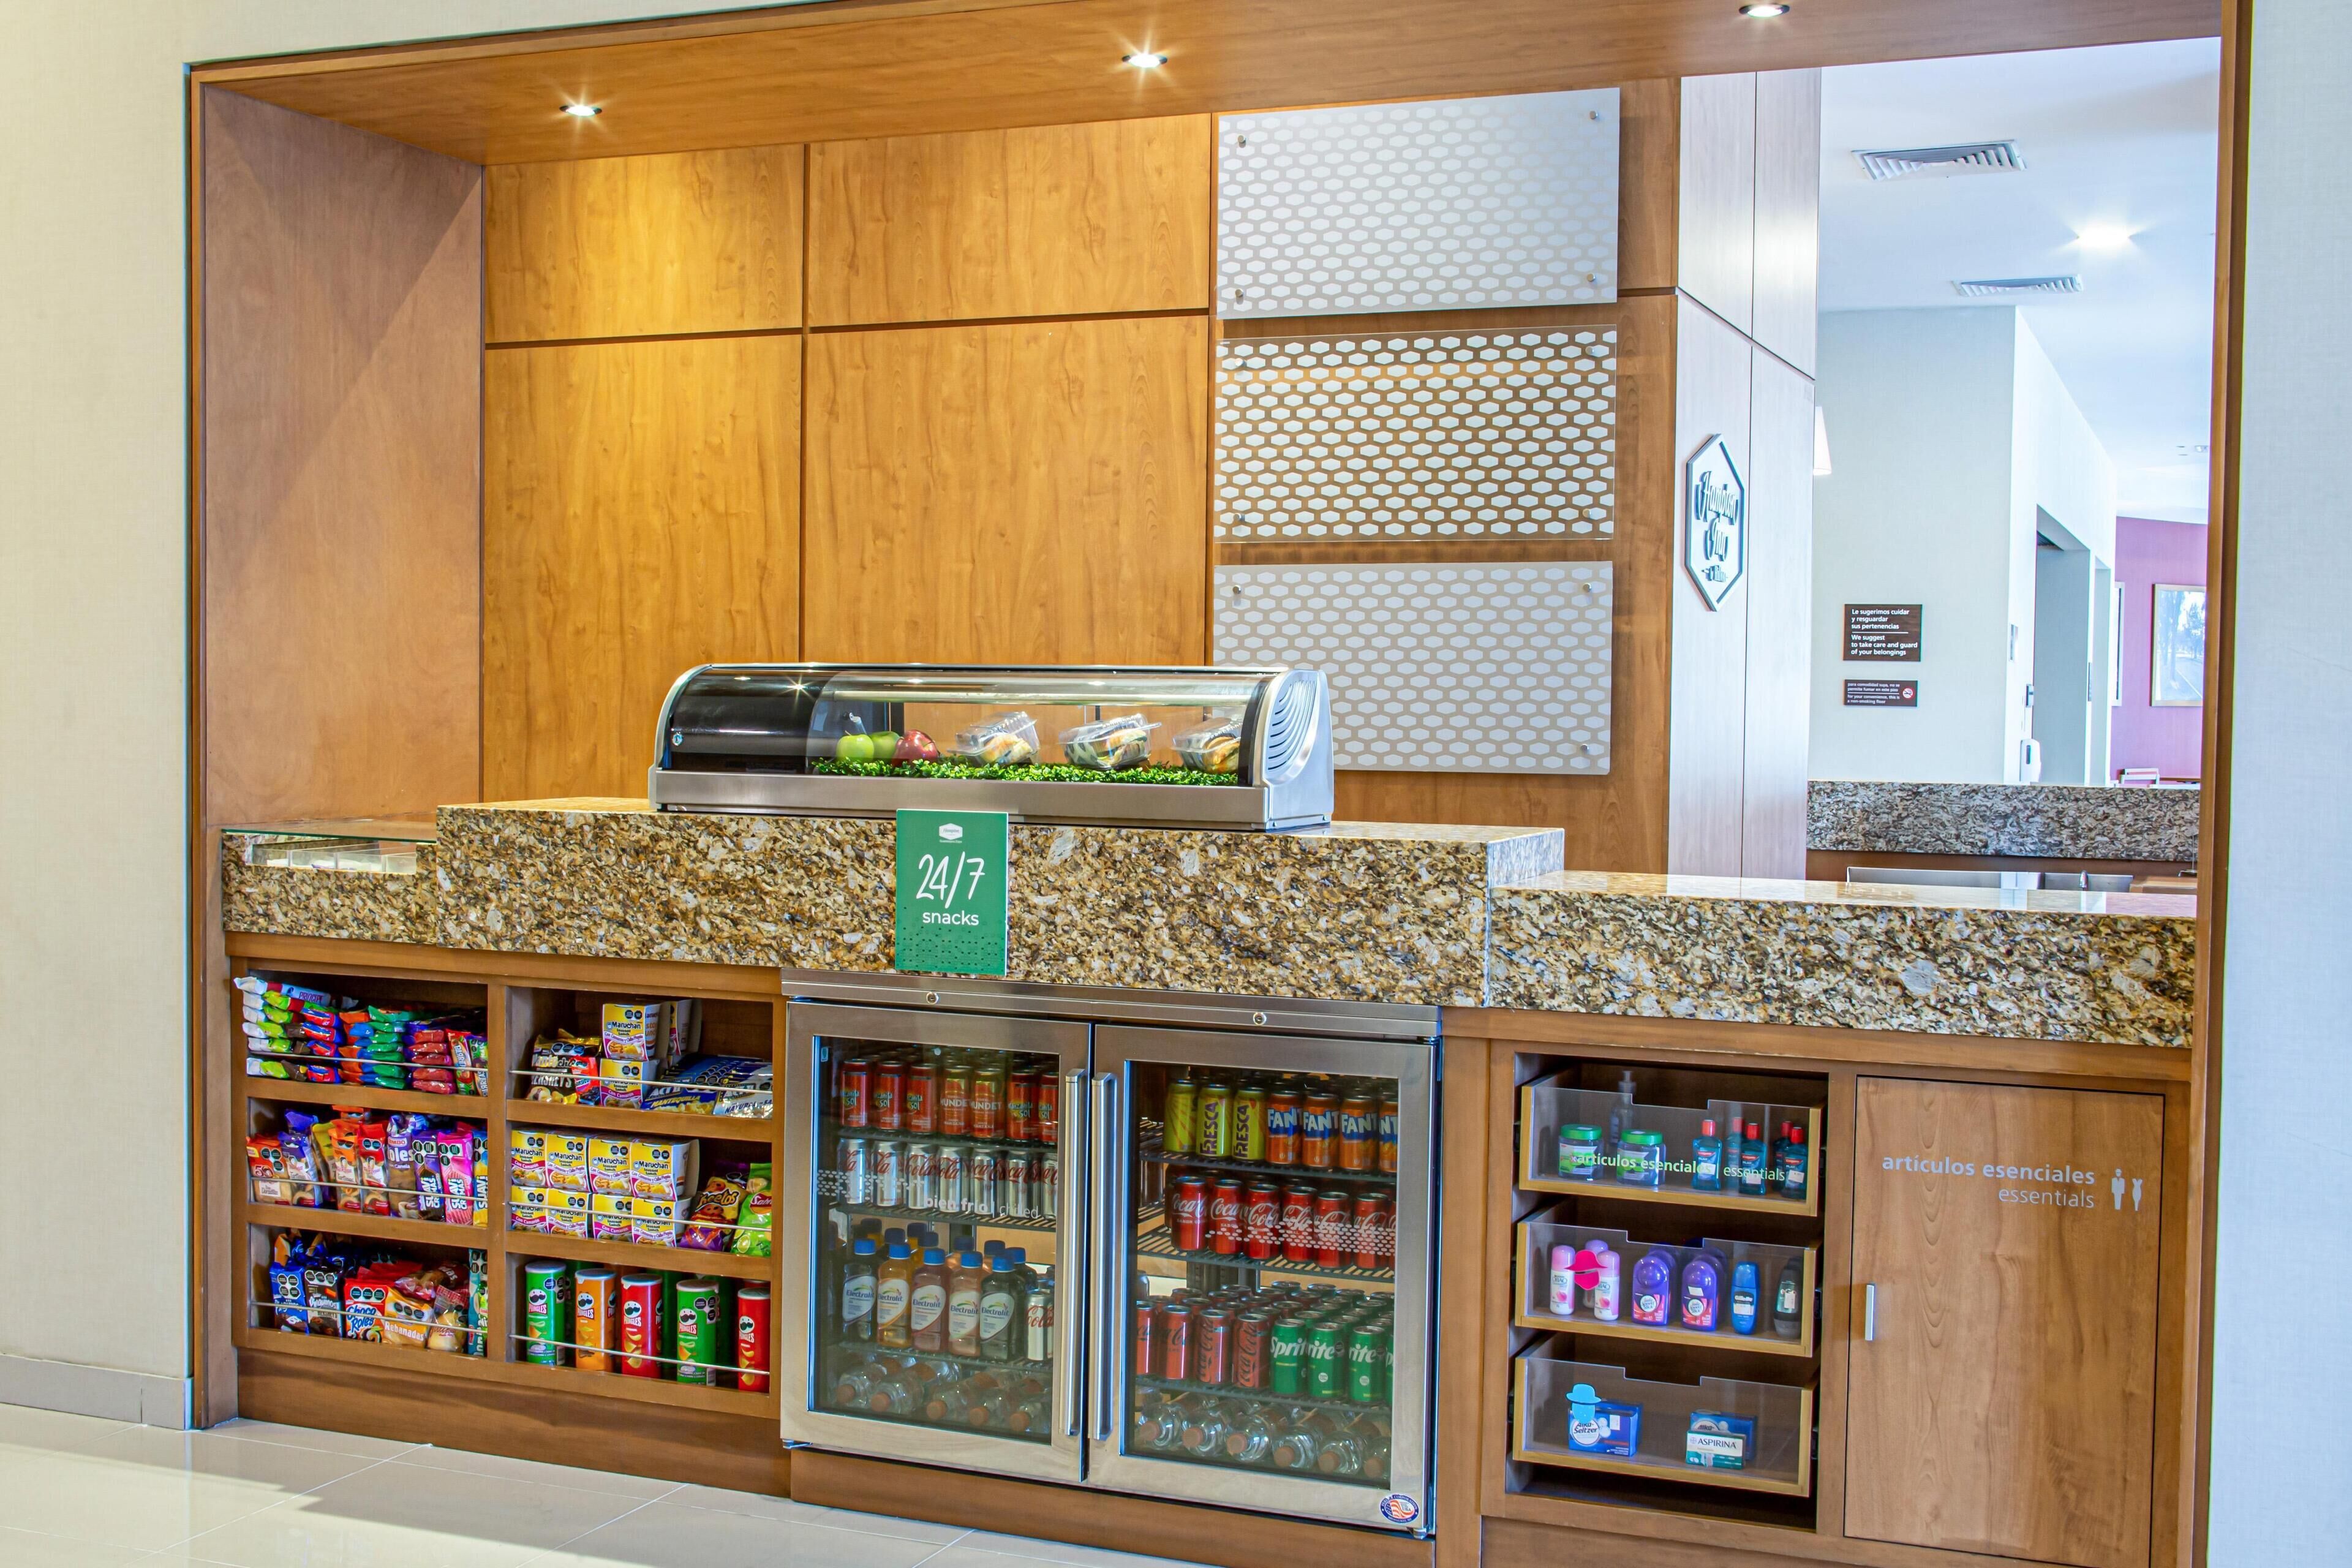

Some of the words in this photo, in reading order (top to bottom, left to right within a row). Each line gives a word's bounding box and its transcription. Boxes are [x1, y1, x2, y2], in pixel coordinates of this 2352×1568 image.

[916, 851, 985, 909] 24/7
[922, 910, 979, 925] snacks
[1267, 1107, 1303, 1128] FANT
[1303, 1110, 1340, 1132] FANT
[1341, 1112, 1378, 1134] FANT
[1200, 1102, 1218, 1155] FRESCA
[1233, 1104, 1250, 1158] FRESCA
[388, 1148, 415, 1163] oles
[514, 1147, 543, 1156] Maruchan
[554, 1152, 582, 1161] Maruchan
[598, 1156, 627, 1165] Maruchan
[639, 1161, 668, 1169] Maruchan
[1577, 1153, 1637, 1168] artículos
[1640, 1159, 1712, 1174] esenciales
[1723, 1166, 1785, 1182] essentials
[1882, 1155, 1975, 1176] artículos
[1982, 1164, 2095, 1185] esenciales
[696, 1188, 739, 1210] heetos
[1998, 1187, 2095, 1208] essentials
[927, 1195, 960, 1211] bien
[999, 1202, 1039, 1219] chilled
[846, 1289, 875, 1298] Electrolit
[878, 1293, 903, 1302] Electrolit
[529, 1303, 547, 1314] PRINGLES
[913, 1298, 941, 1308] Electrolit
[950, 1305, 979, 1314] Electrolit
[577, 1307, 594, 1319] PRINGLES
[981, 1306, 1009, 1316] Electrolit
[351, 1316, 374, 1333] Roles
[624, 1316, 641, 1327] PRINGLES
[679, 1323, 697, 1335] PRINGLES
[385, 1321, 424, 1341] Rebanadas
[739, 1332, 755, 1343] PRINGLES
[1270, 1336, 1308, 1359] Sprit
[1308, 1340, 1335, 1360] rite
[1349, 1343, 1377, 1363] rite
[1697, 1438, 1736, 1449] ASPIRINA
